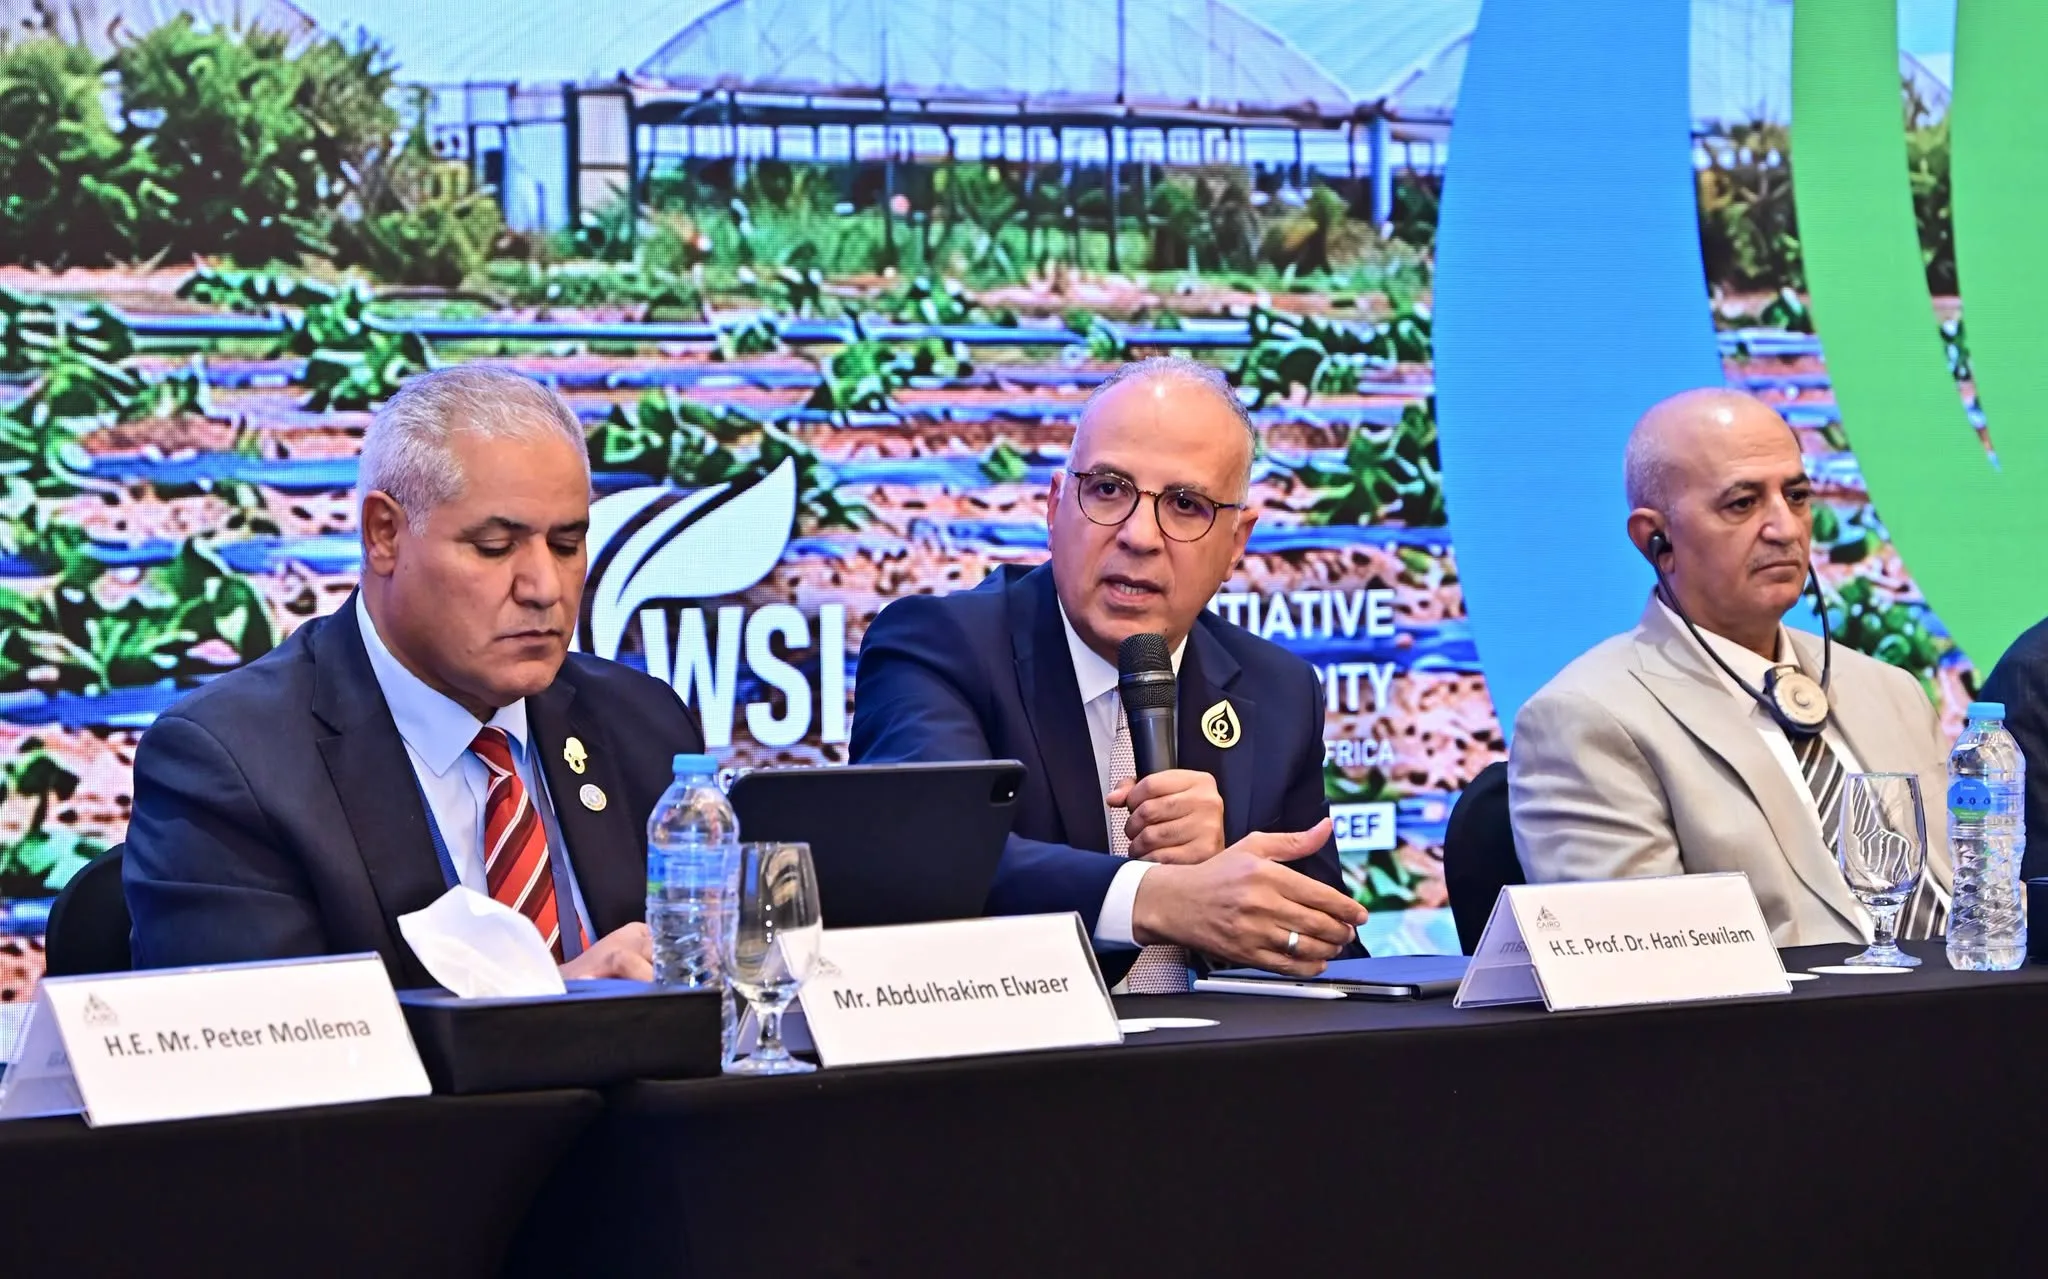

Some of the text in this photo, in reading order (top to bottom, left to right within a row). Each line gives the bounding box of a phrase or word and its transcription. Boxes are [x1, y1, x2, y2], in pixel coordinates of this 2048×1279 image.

[640, 603, 846, 748] WSI
[1312, 662, 1396, 711] ITY
[1549, 938, 1584, 957] H.E.
[1584, 935, 1624, 955] Prof.
[1627, 933, 1649, 951] Dr.
[1652, 930, 1688, 950] Hani
[1688, 926, 1755, 947] Sewilam
[833, 974, 1070, 1009] Mr. Abdulhakim Elwaer
[104, 1018, 372, 1057] H.E. Mr. Peter Mollema
